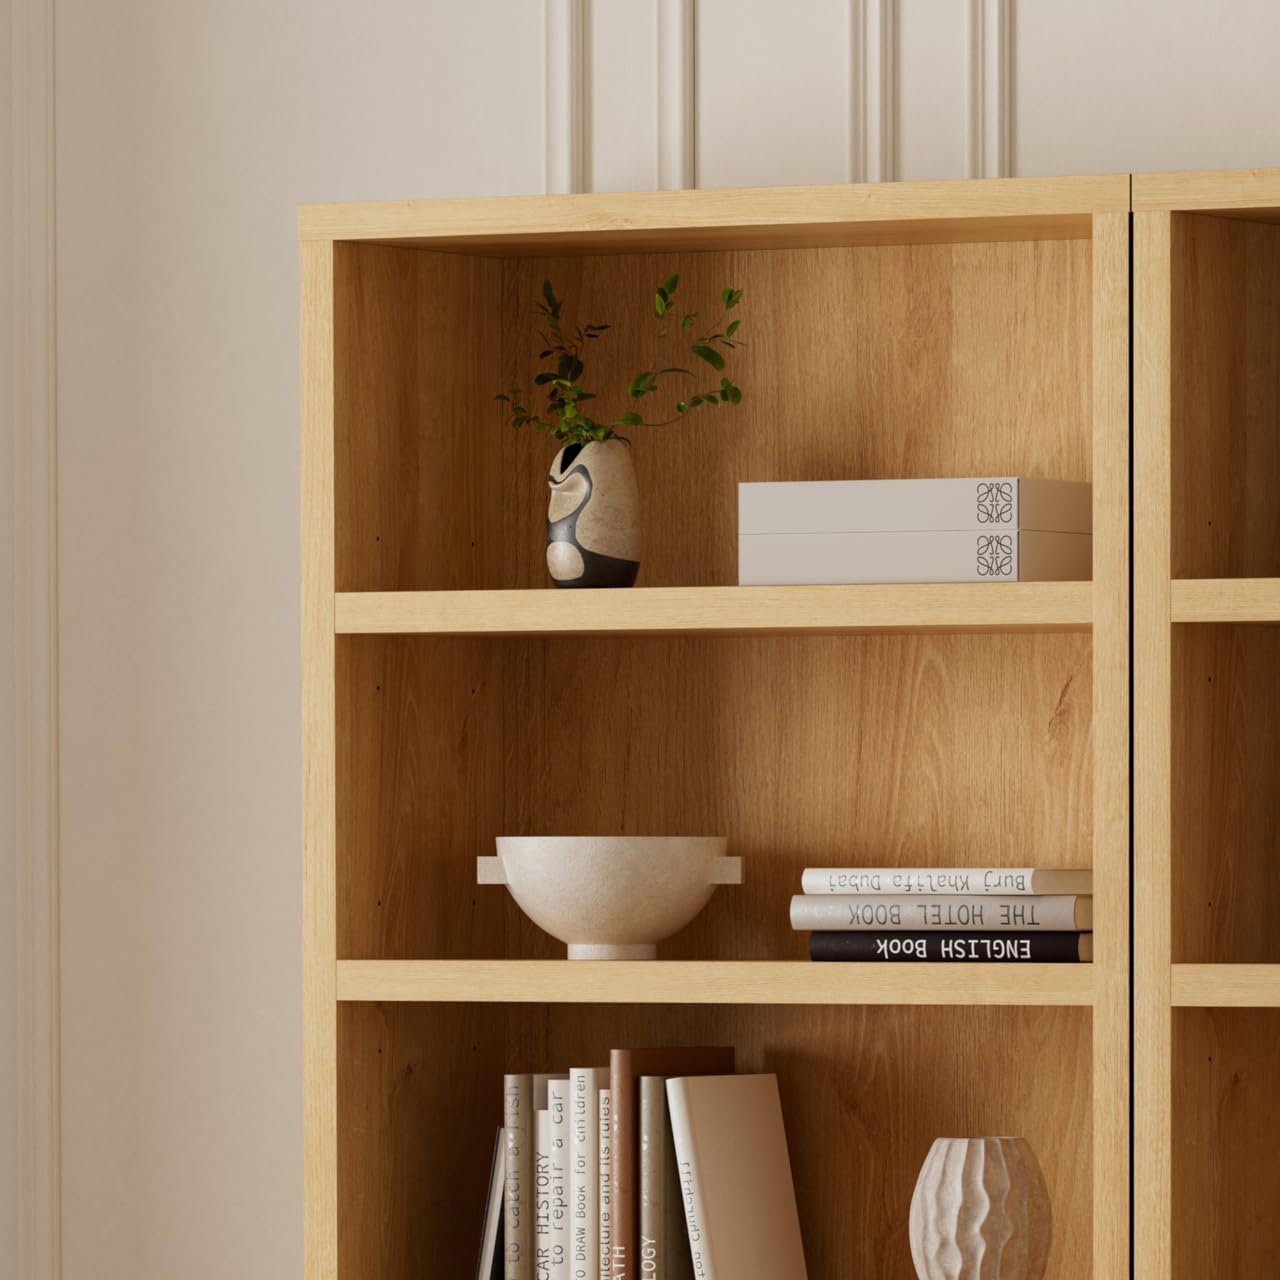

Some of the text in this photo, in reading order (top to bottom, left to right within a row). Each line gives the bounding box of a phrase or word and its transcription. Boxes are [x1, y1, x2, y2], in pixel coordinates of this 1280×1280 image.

[828, 870, 1026, 892] Burj Khalifa Dubai
[849, 904, 1040, 926] THE HOTEL BOOK
[876, 938, 1032, 959] ENGLISH Book
[552, 1091, 563, 1125] car
[600, 1096, 610, 1139] rules
[552, 1138, 563, 1149] a
[575, 1152, 586, 1175] for
[600, 1146, 610, 1166] its
[536, 1152, 549, 1234] HISTORY
[551, 1162, 568, 1230] repair
[600, 1173, 610, 1204] and
[551, 1245, 563, 1265] to
[576, 1227, 586, 1261] DRAW
